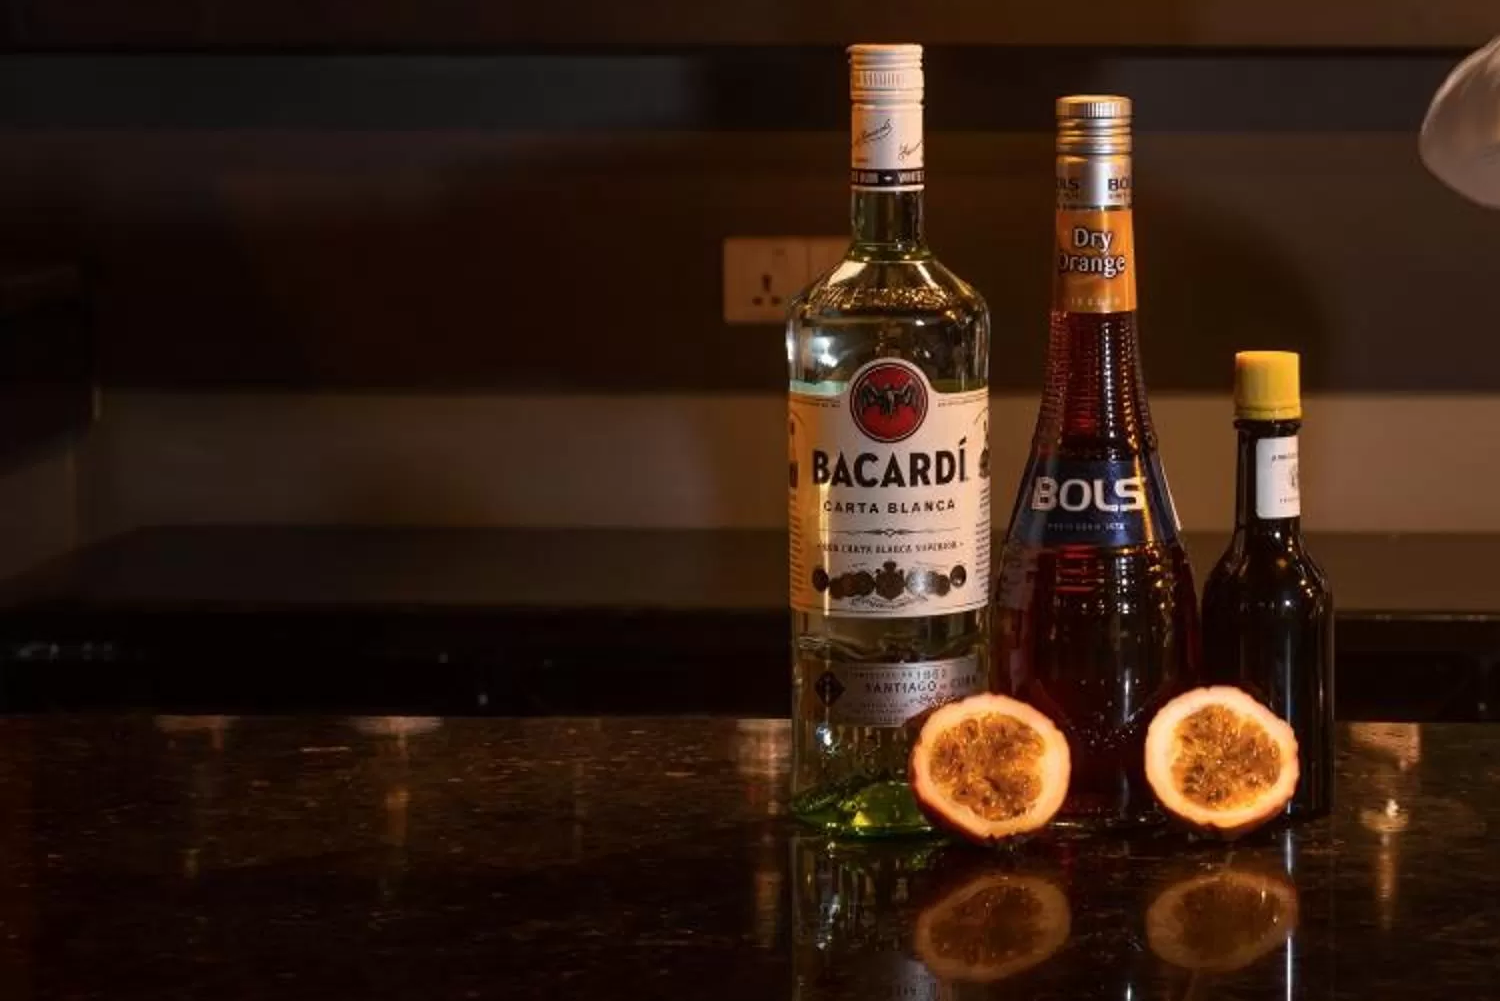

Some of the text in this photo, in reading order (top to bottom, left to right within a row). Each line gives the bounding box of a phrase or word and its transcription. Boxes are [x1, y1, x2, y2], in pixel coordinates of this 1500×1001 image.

[1072, 227, 1113, 253] Dry
[811, 436, 967, 488] BACARDÍ
[823, 499, 956, 514] CARTA BLANCA
[1031, 476, 1147, 512] BOLS
[864, 680, 936, 694] SANTIAGO
